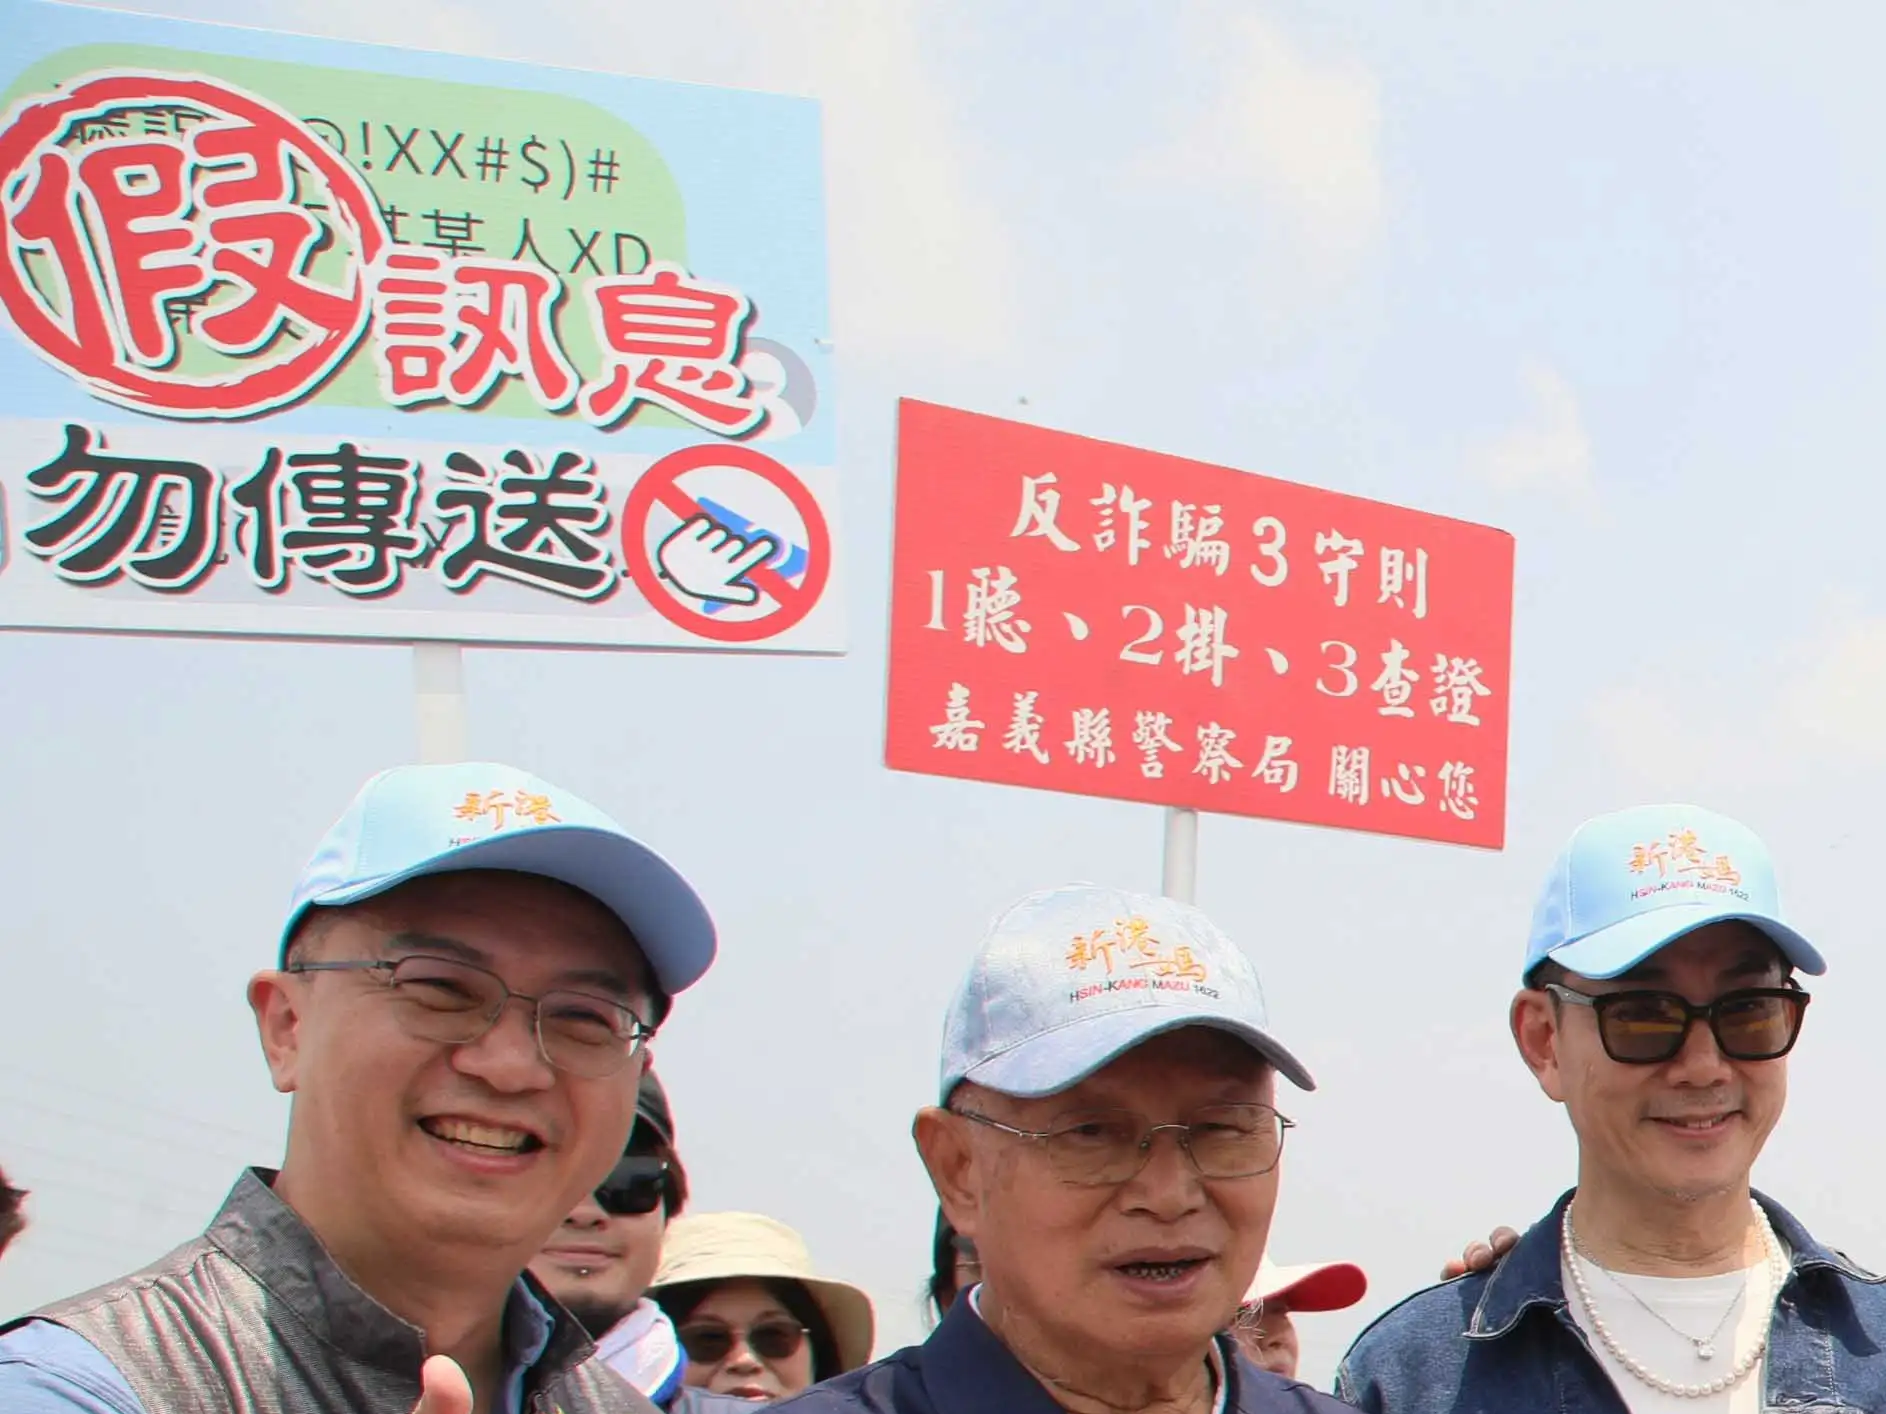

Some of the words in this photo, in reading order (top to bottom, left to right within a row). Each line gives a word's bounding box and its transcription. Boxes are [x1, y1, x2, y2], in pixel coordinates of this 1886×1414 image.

[24, 422, 614, 600] 勿傳送
[1009, 471, 1428, 620] 反詐騙3守則
[929, 681, 1300, 793] 嘉義縣警察局
[1328, 744, 1480, 820] 關心您
[1069, 978, 1148, 1003] HSIN-KANG
[1152, 979, 1190, 992] MAZU
